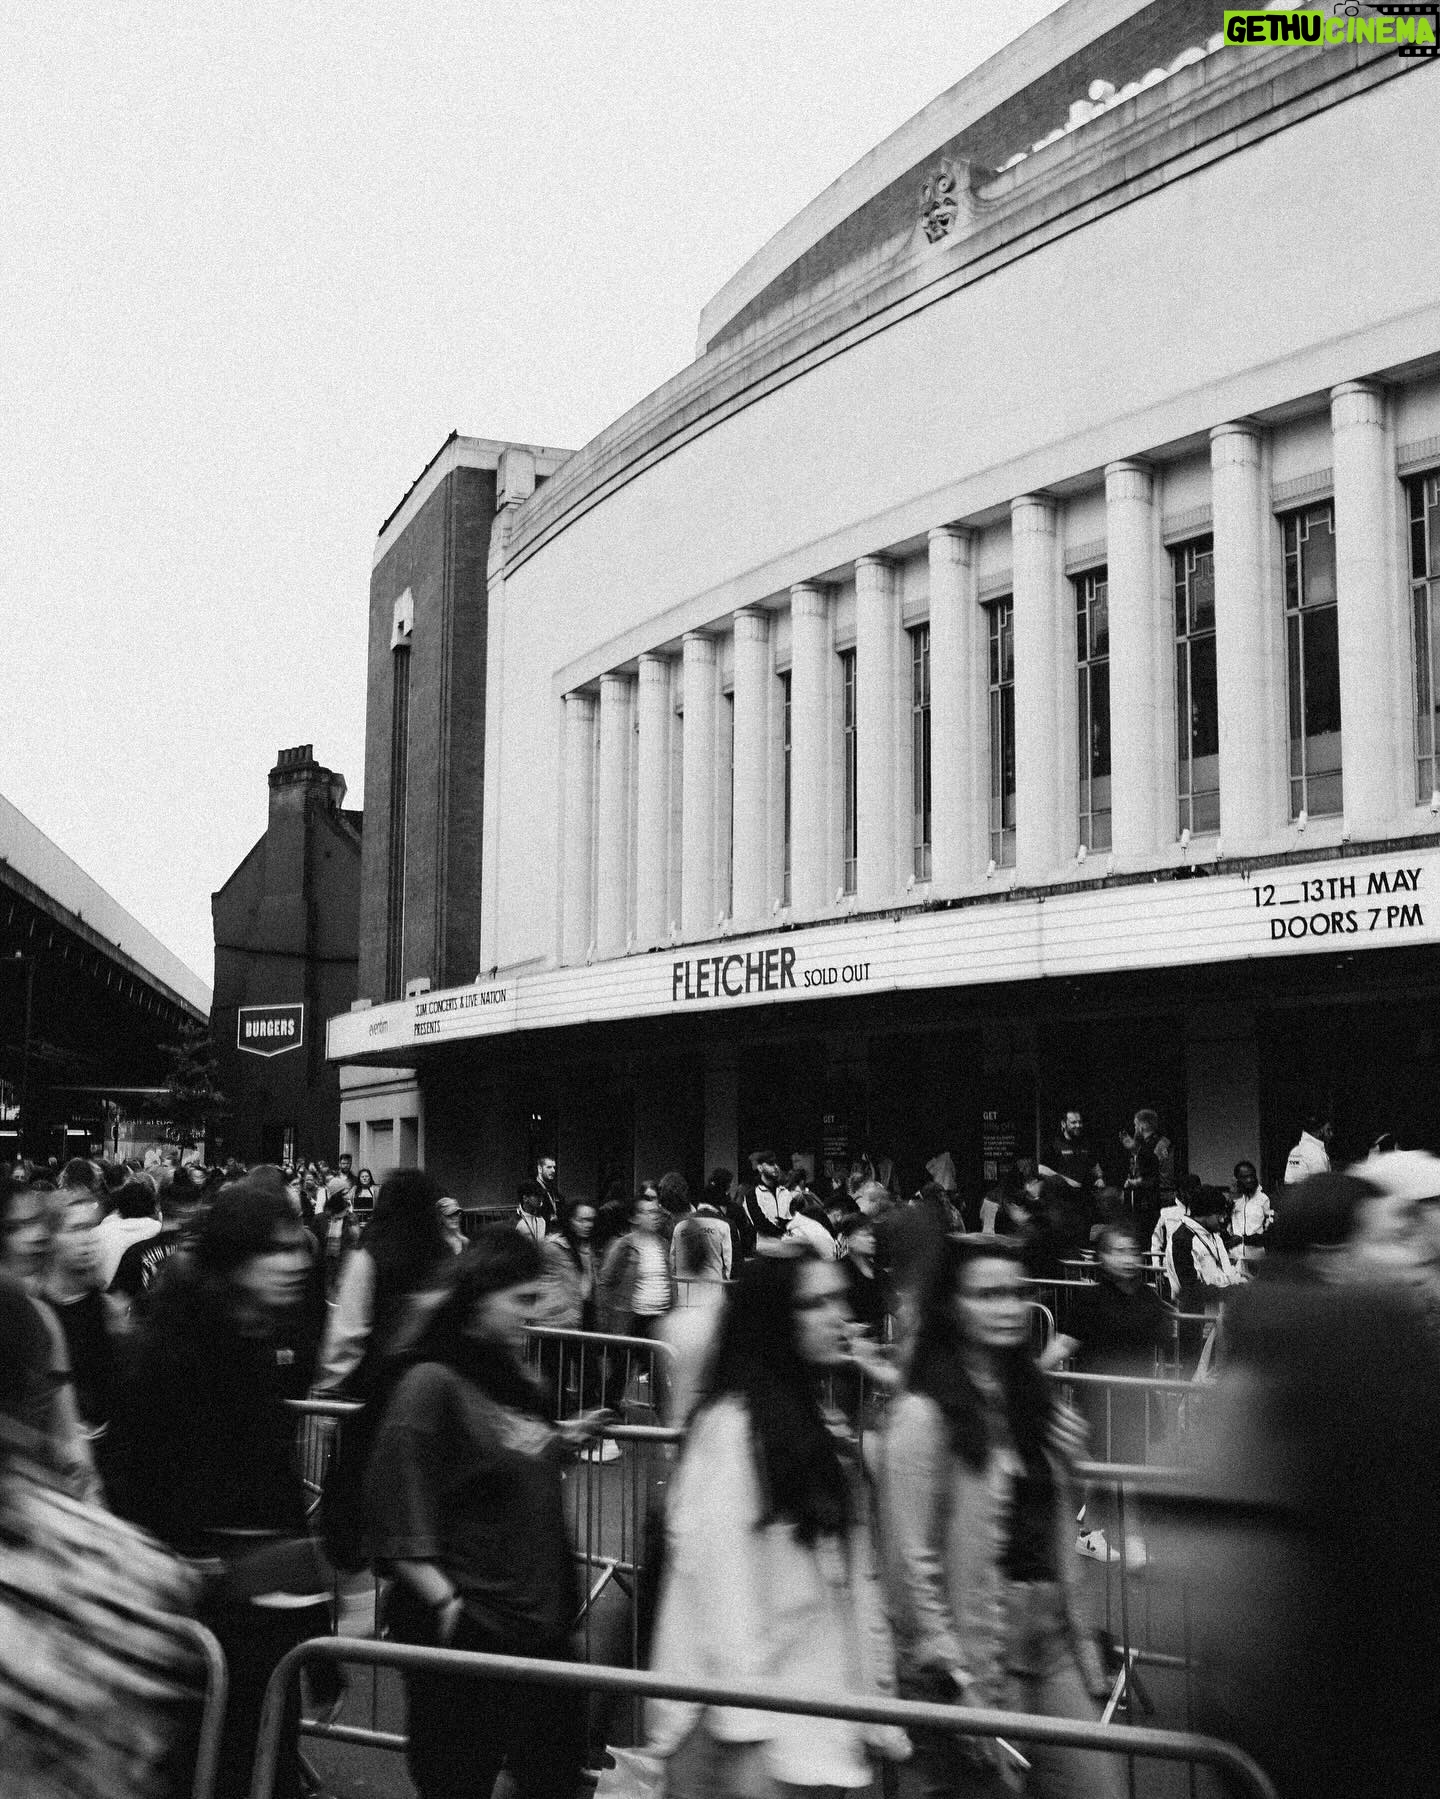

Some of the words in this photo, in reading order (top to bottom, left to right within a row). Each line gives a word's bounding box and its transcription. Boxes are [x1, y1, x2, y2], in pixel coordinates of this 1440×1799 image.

[1366, 867, 1422, 896] MAY
[1270, 910, 1359, 940] DOORS
[672, 946, 797, 1001] FLETCHER
[803, 966, 838, 988] SOLD
[842, 962, 871, 983] OUT
[428, 997, 458, 1014] CONCERTS
[460, 996, 465, 1009] &
[465, 993, 479, 1008] LIVE
[480, 988, 507, 1005] NATION
[245, 1018, 295, 1038] BURGERS
[413, 1020, 441, 1036] PRESENTS
